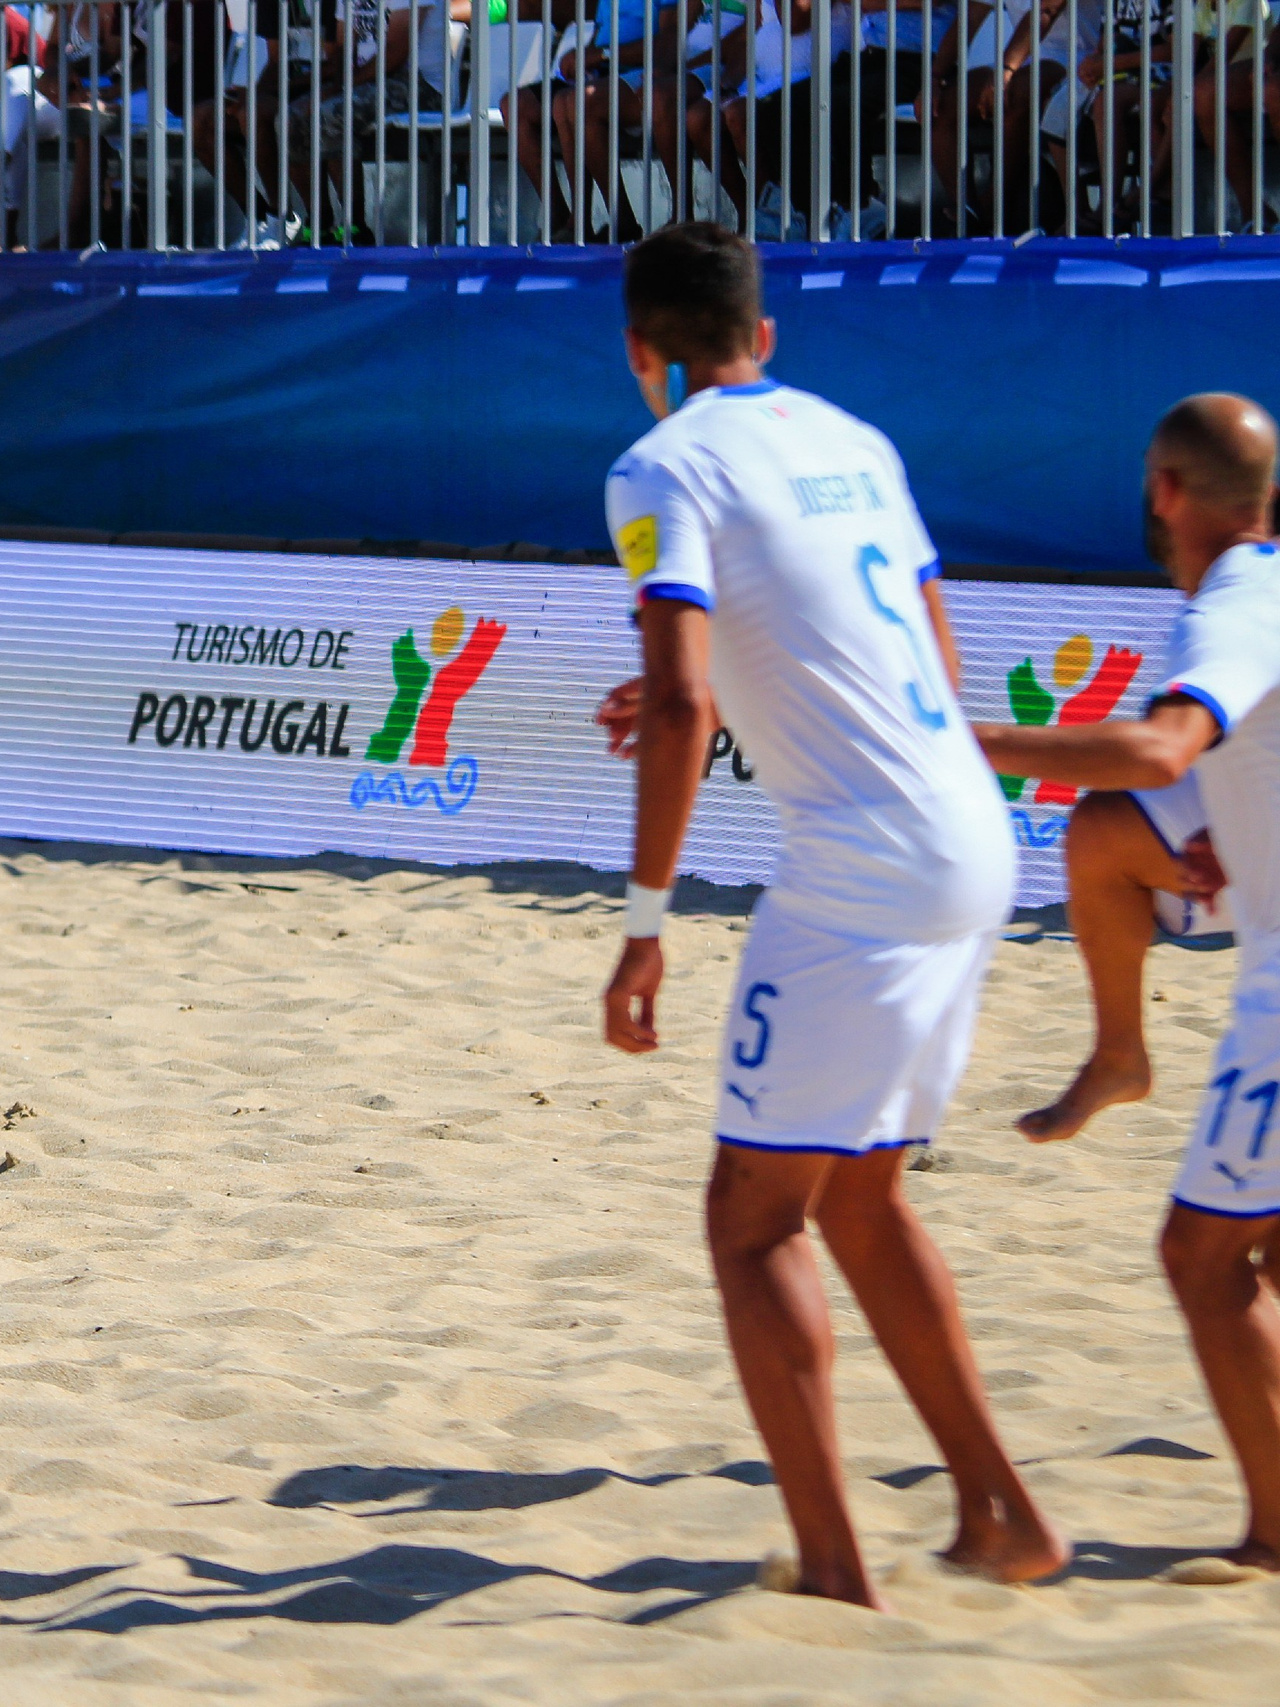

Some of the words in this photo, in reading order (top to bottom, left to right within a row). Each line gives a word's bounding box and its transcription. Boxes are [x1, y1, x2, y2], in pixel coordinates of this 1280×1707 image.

[171, 622, 305, 668] TURISMO
[308, 629, 354, 670] DE
[127, 691, 351, 758] PORTUGAL
[732, 981, 781, 1069] 5
[1205, 1067, 1280, 1160] 11
